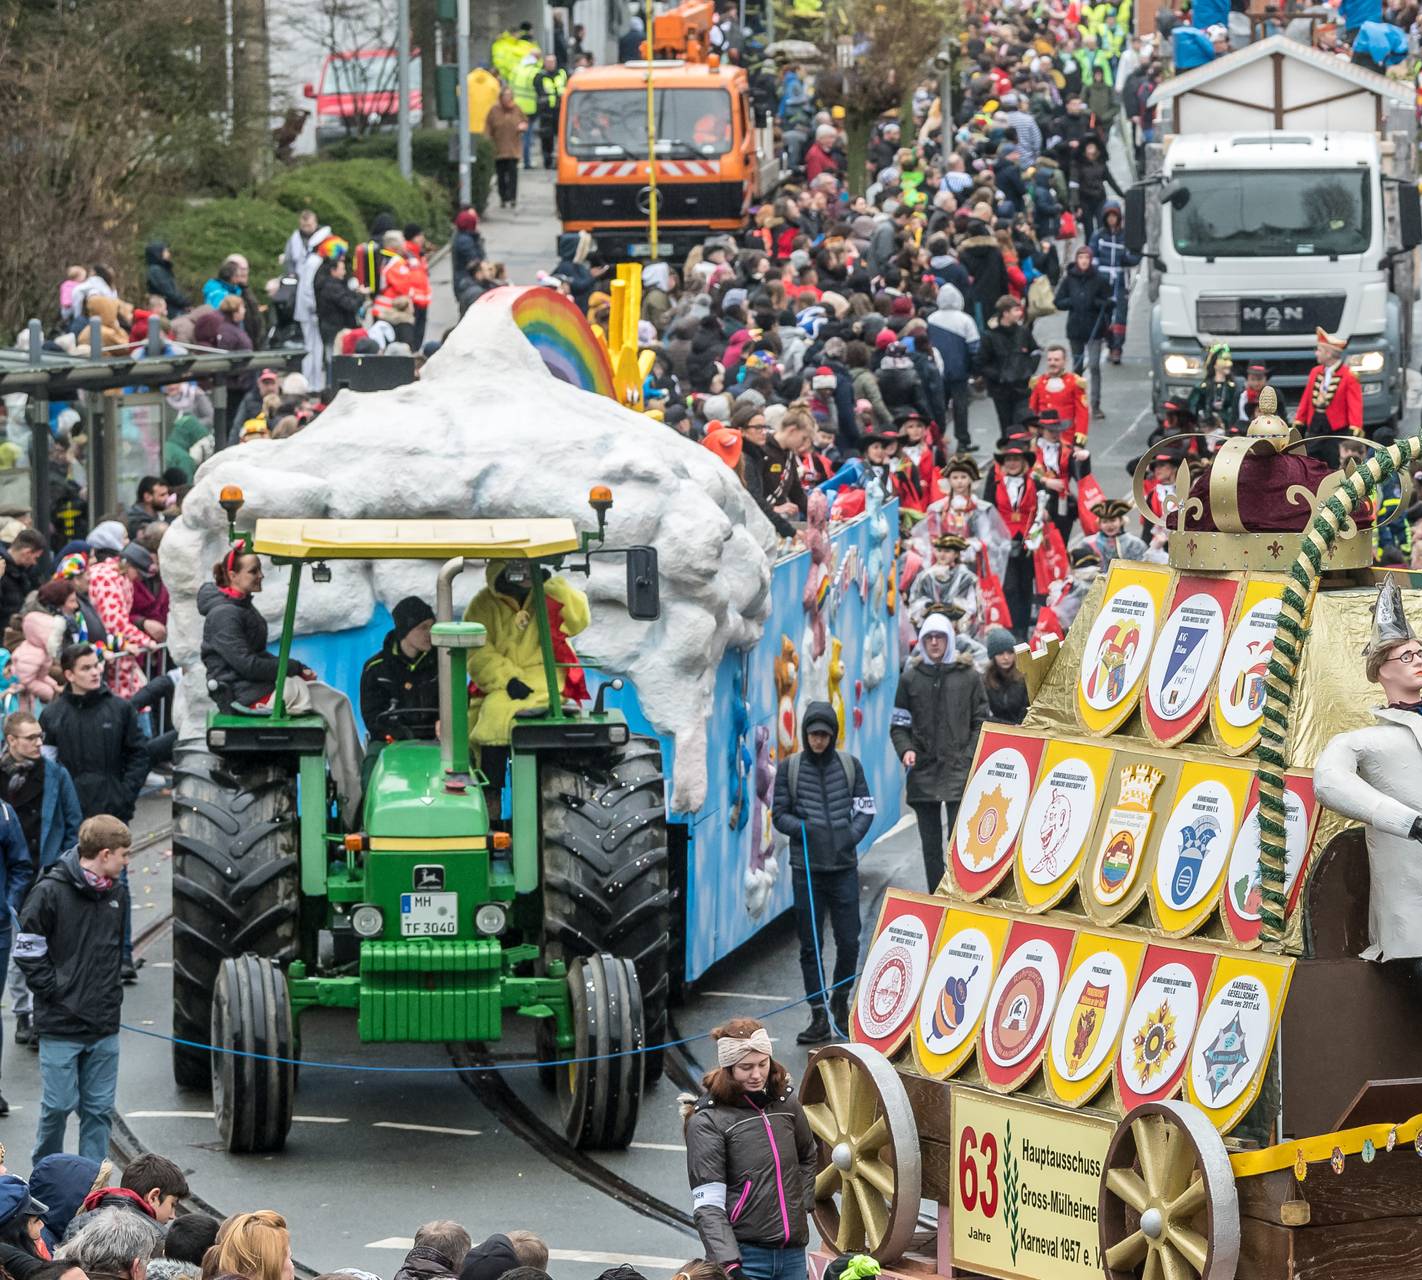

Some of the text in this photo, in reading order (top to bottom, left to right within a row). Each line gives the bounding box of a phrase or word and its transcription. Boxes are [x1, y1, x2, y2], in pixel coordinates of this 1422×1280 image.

[1243, 307, 1303, 320] MAN
[415, 896, 431, 907] MH
[405, 922, 455, 933] TF 3040
[1232, 981, 1259, 991] KARNEVALS-
[1227, 989, 1259, 1001] GESELLSCHAFT
[1242, 1000, 1253, 1009] 2017
[1022, 1138, 1100, 1177] Hauptausschuss
[959, 1126, 998, 1218] 63
[968, 1226, 991, 1243] Jahre
[1021, 1228, 1058, 1258] Karneval
[1061, 1238, 1080, 1263] 1957
[1084, 1250, 1092, 1266] e.
